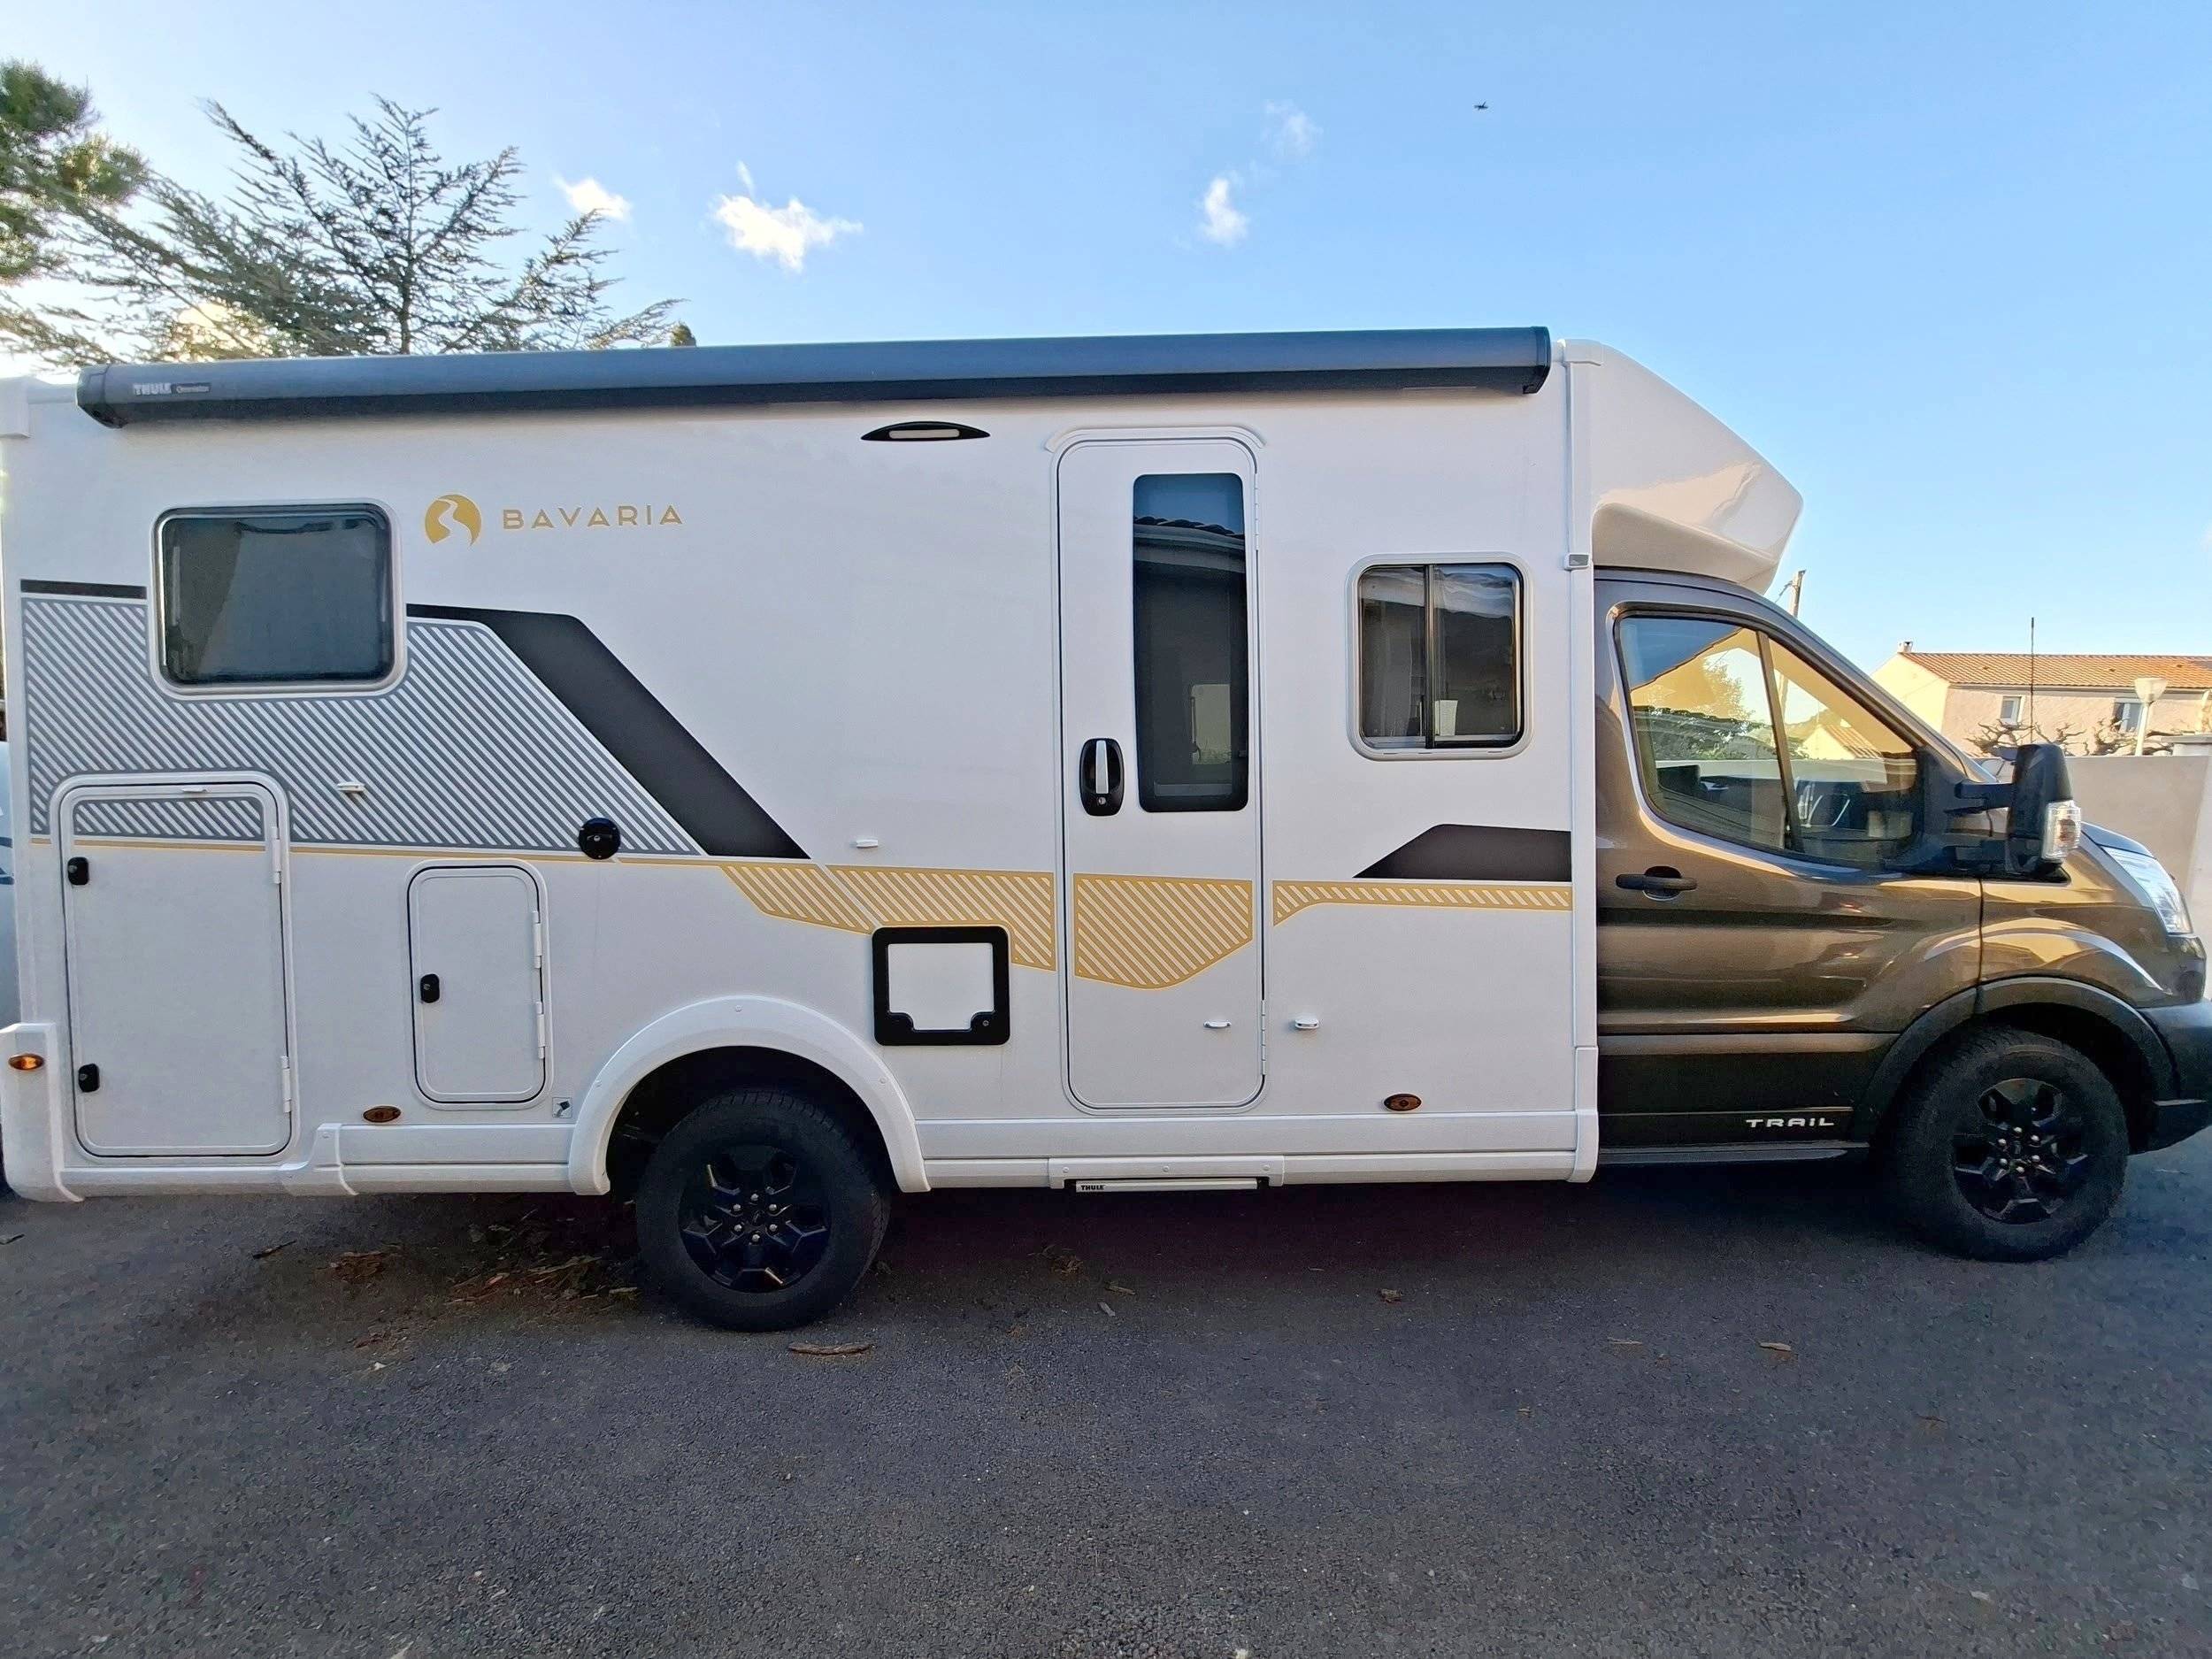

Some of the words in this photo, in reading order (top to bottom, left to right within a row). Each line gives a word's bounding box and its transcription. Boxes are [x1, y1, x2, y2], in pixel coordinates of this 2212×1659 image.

[134, 382, 172, 396] THULE
[503, 504, 683, 530] BAVARIA
[1746, 1118, 1834, 1128] TRAIL
